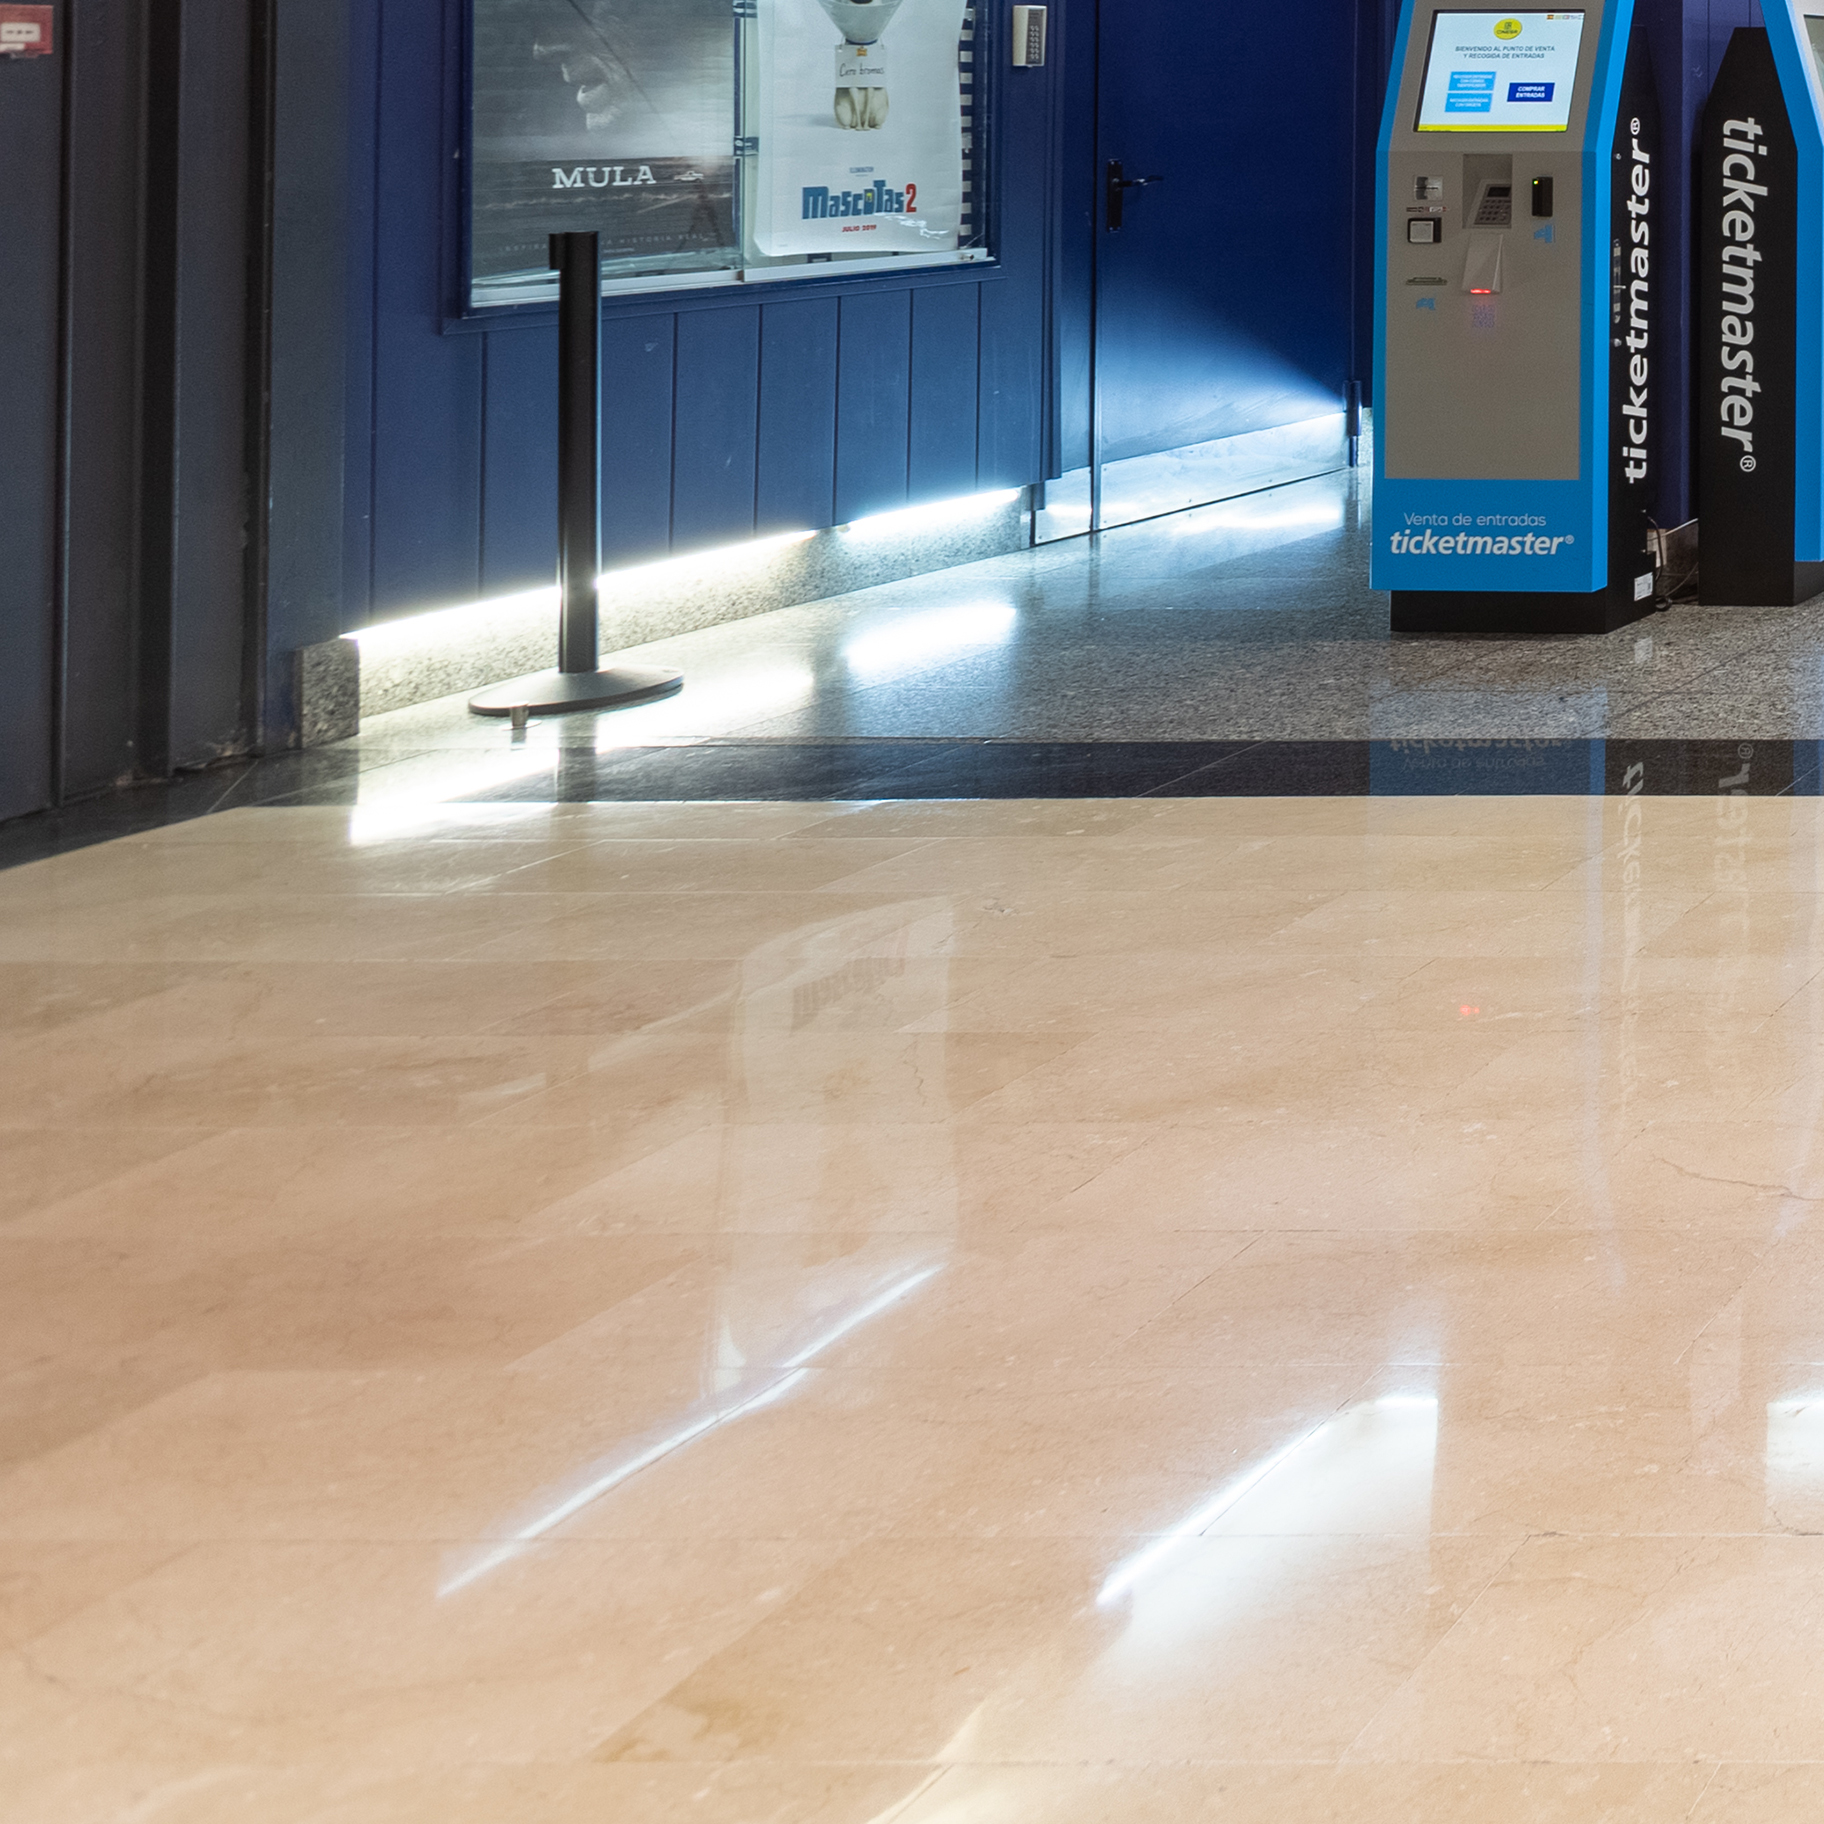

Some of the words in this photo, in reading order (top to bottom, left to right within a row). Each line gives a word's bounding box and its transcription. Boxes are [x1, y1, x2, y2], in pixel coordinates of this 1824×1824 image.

[551, 164, 658, 190] MULA
[906, 183, 918, 214] 2
[1404, 512, 1449, 527] Venta
[1451, 512, 1472, 527] de
[1476, 512, 1548, 527] entradas
